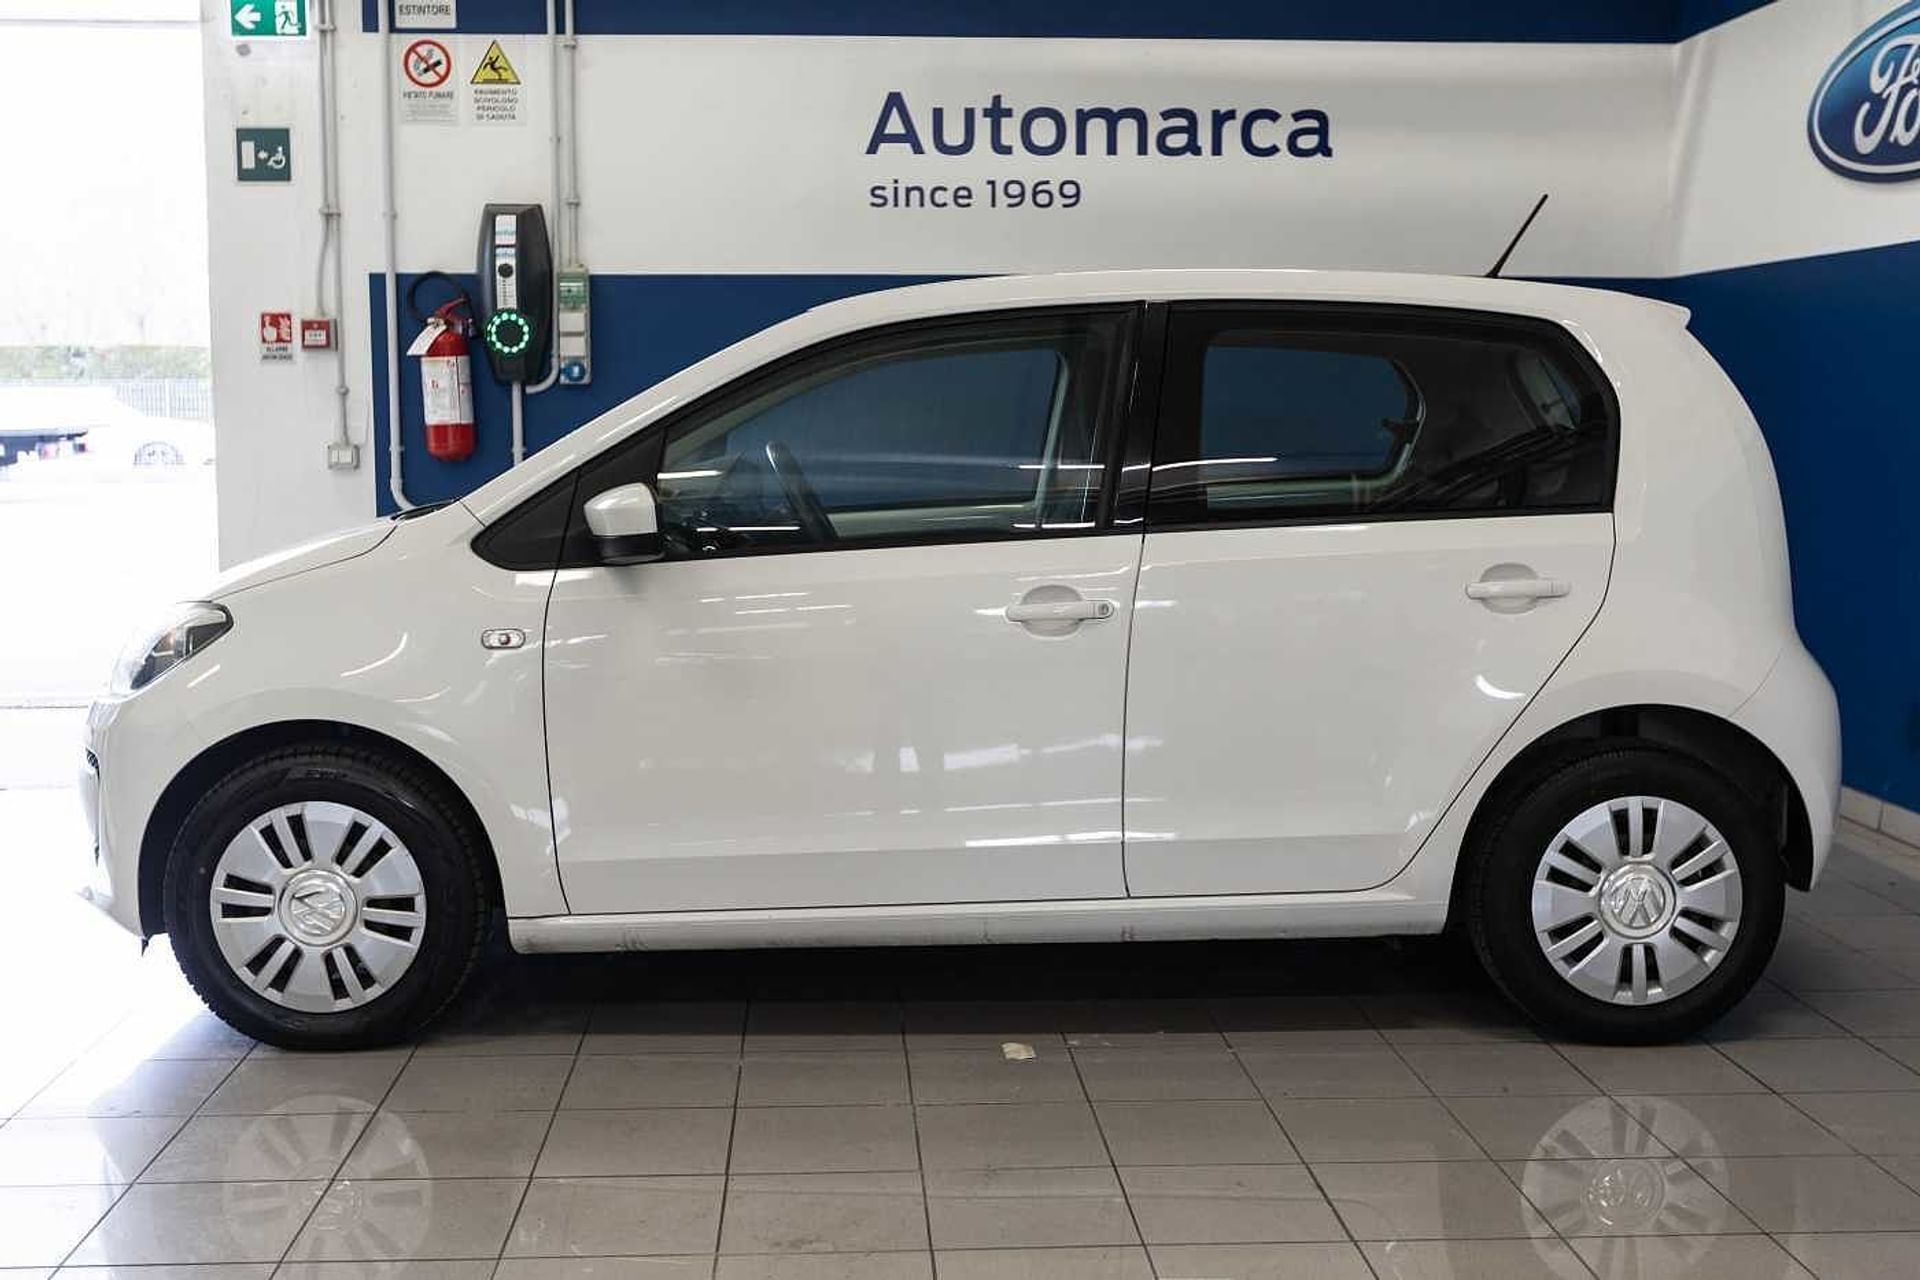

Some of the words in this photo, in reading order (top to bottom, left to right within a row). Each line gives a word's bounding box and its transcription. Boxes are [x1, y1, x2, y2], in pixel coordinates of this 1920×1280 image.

[398, 4, 452, 15] ESTINTORE
[865, 91, 1333, 158] Automarca
[870, 178, 973, 209] since
[986, 179, 1081, 209] 1969
